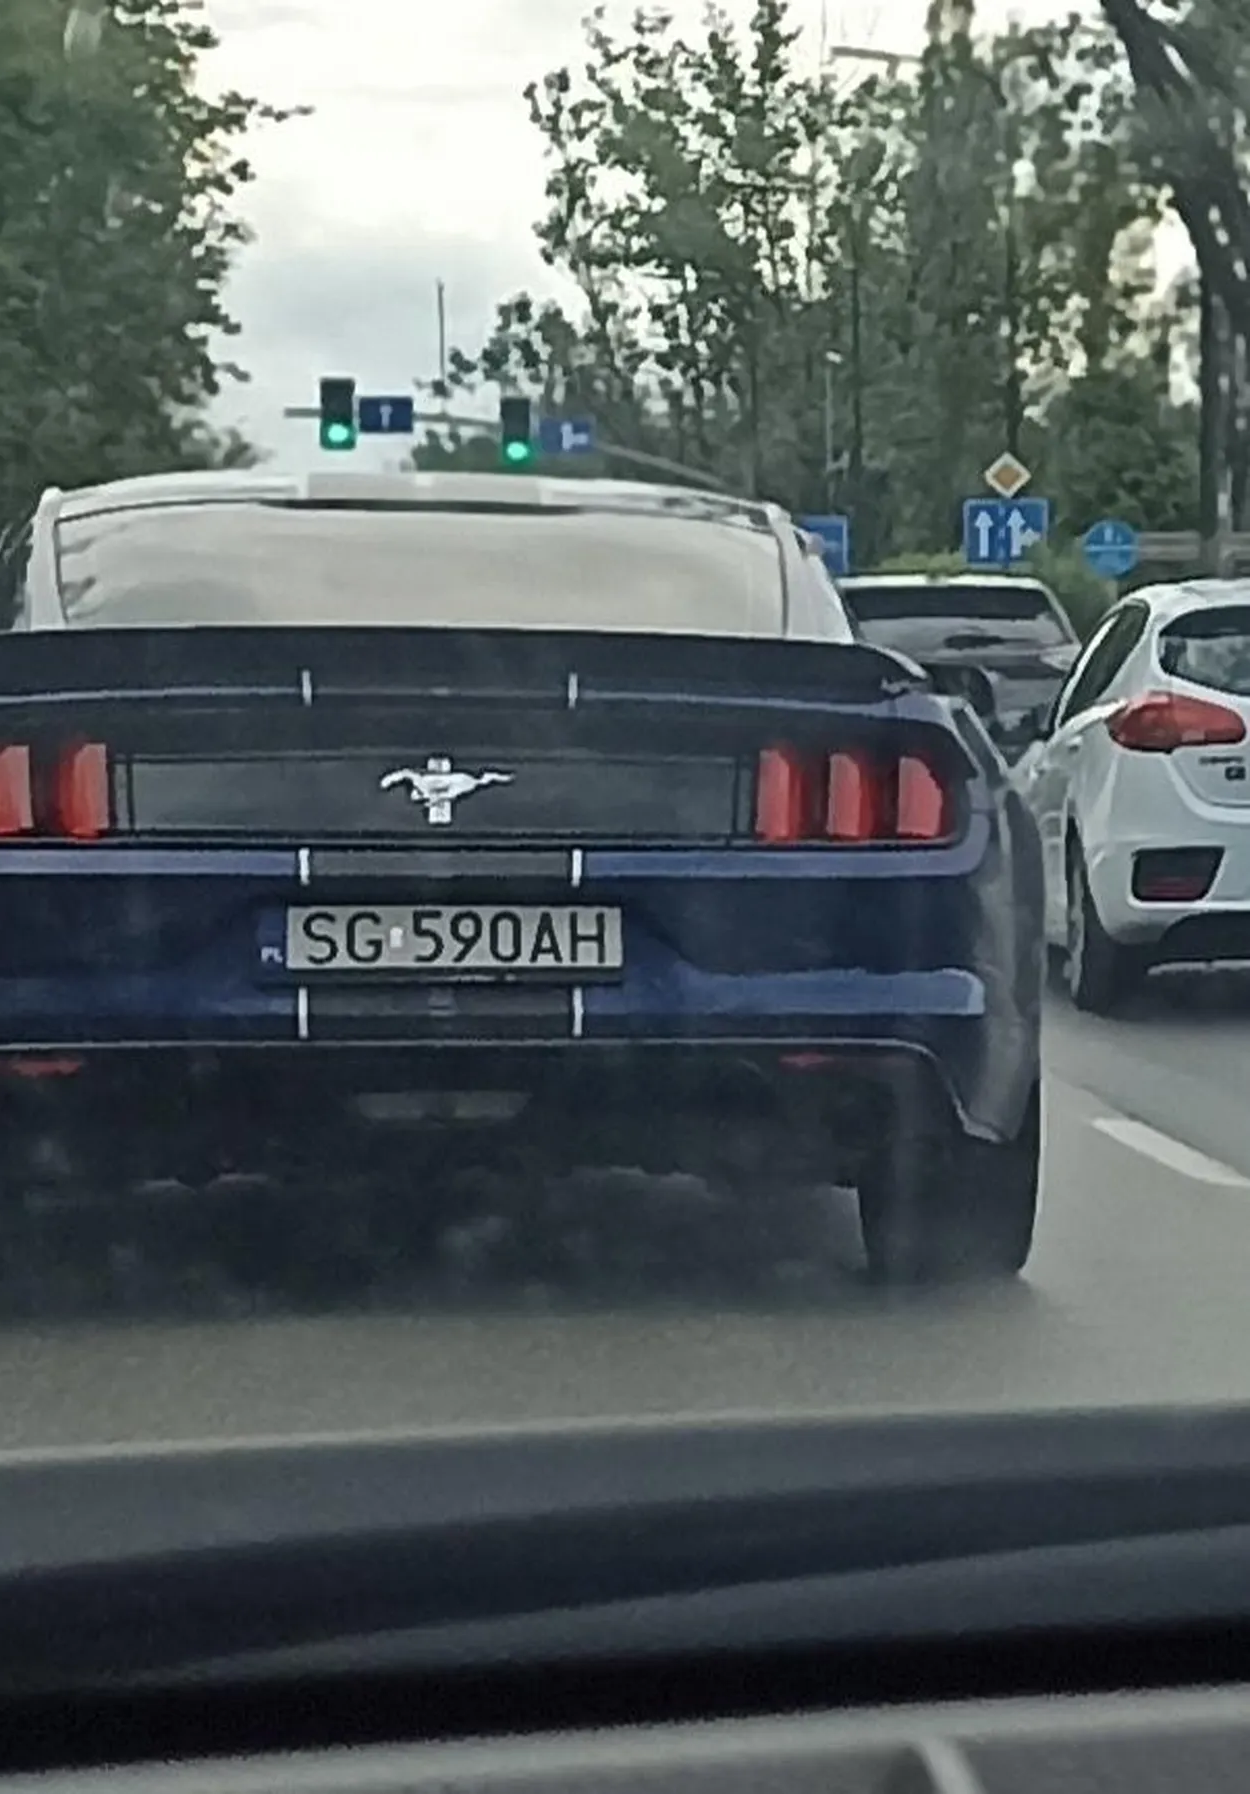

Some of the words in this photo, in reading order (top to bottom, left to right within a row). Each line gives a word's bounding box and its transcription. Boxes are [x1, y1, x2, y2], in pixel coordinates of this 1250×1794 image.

[260, 946, 283, 963] PL
[301, 910, 384, 964] SG
[412, 909, 606, 964] 590AH
